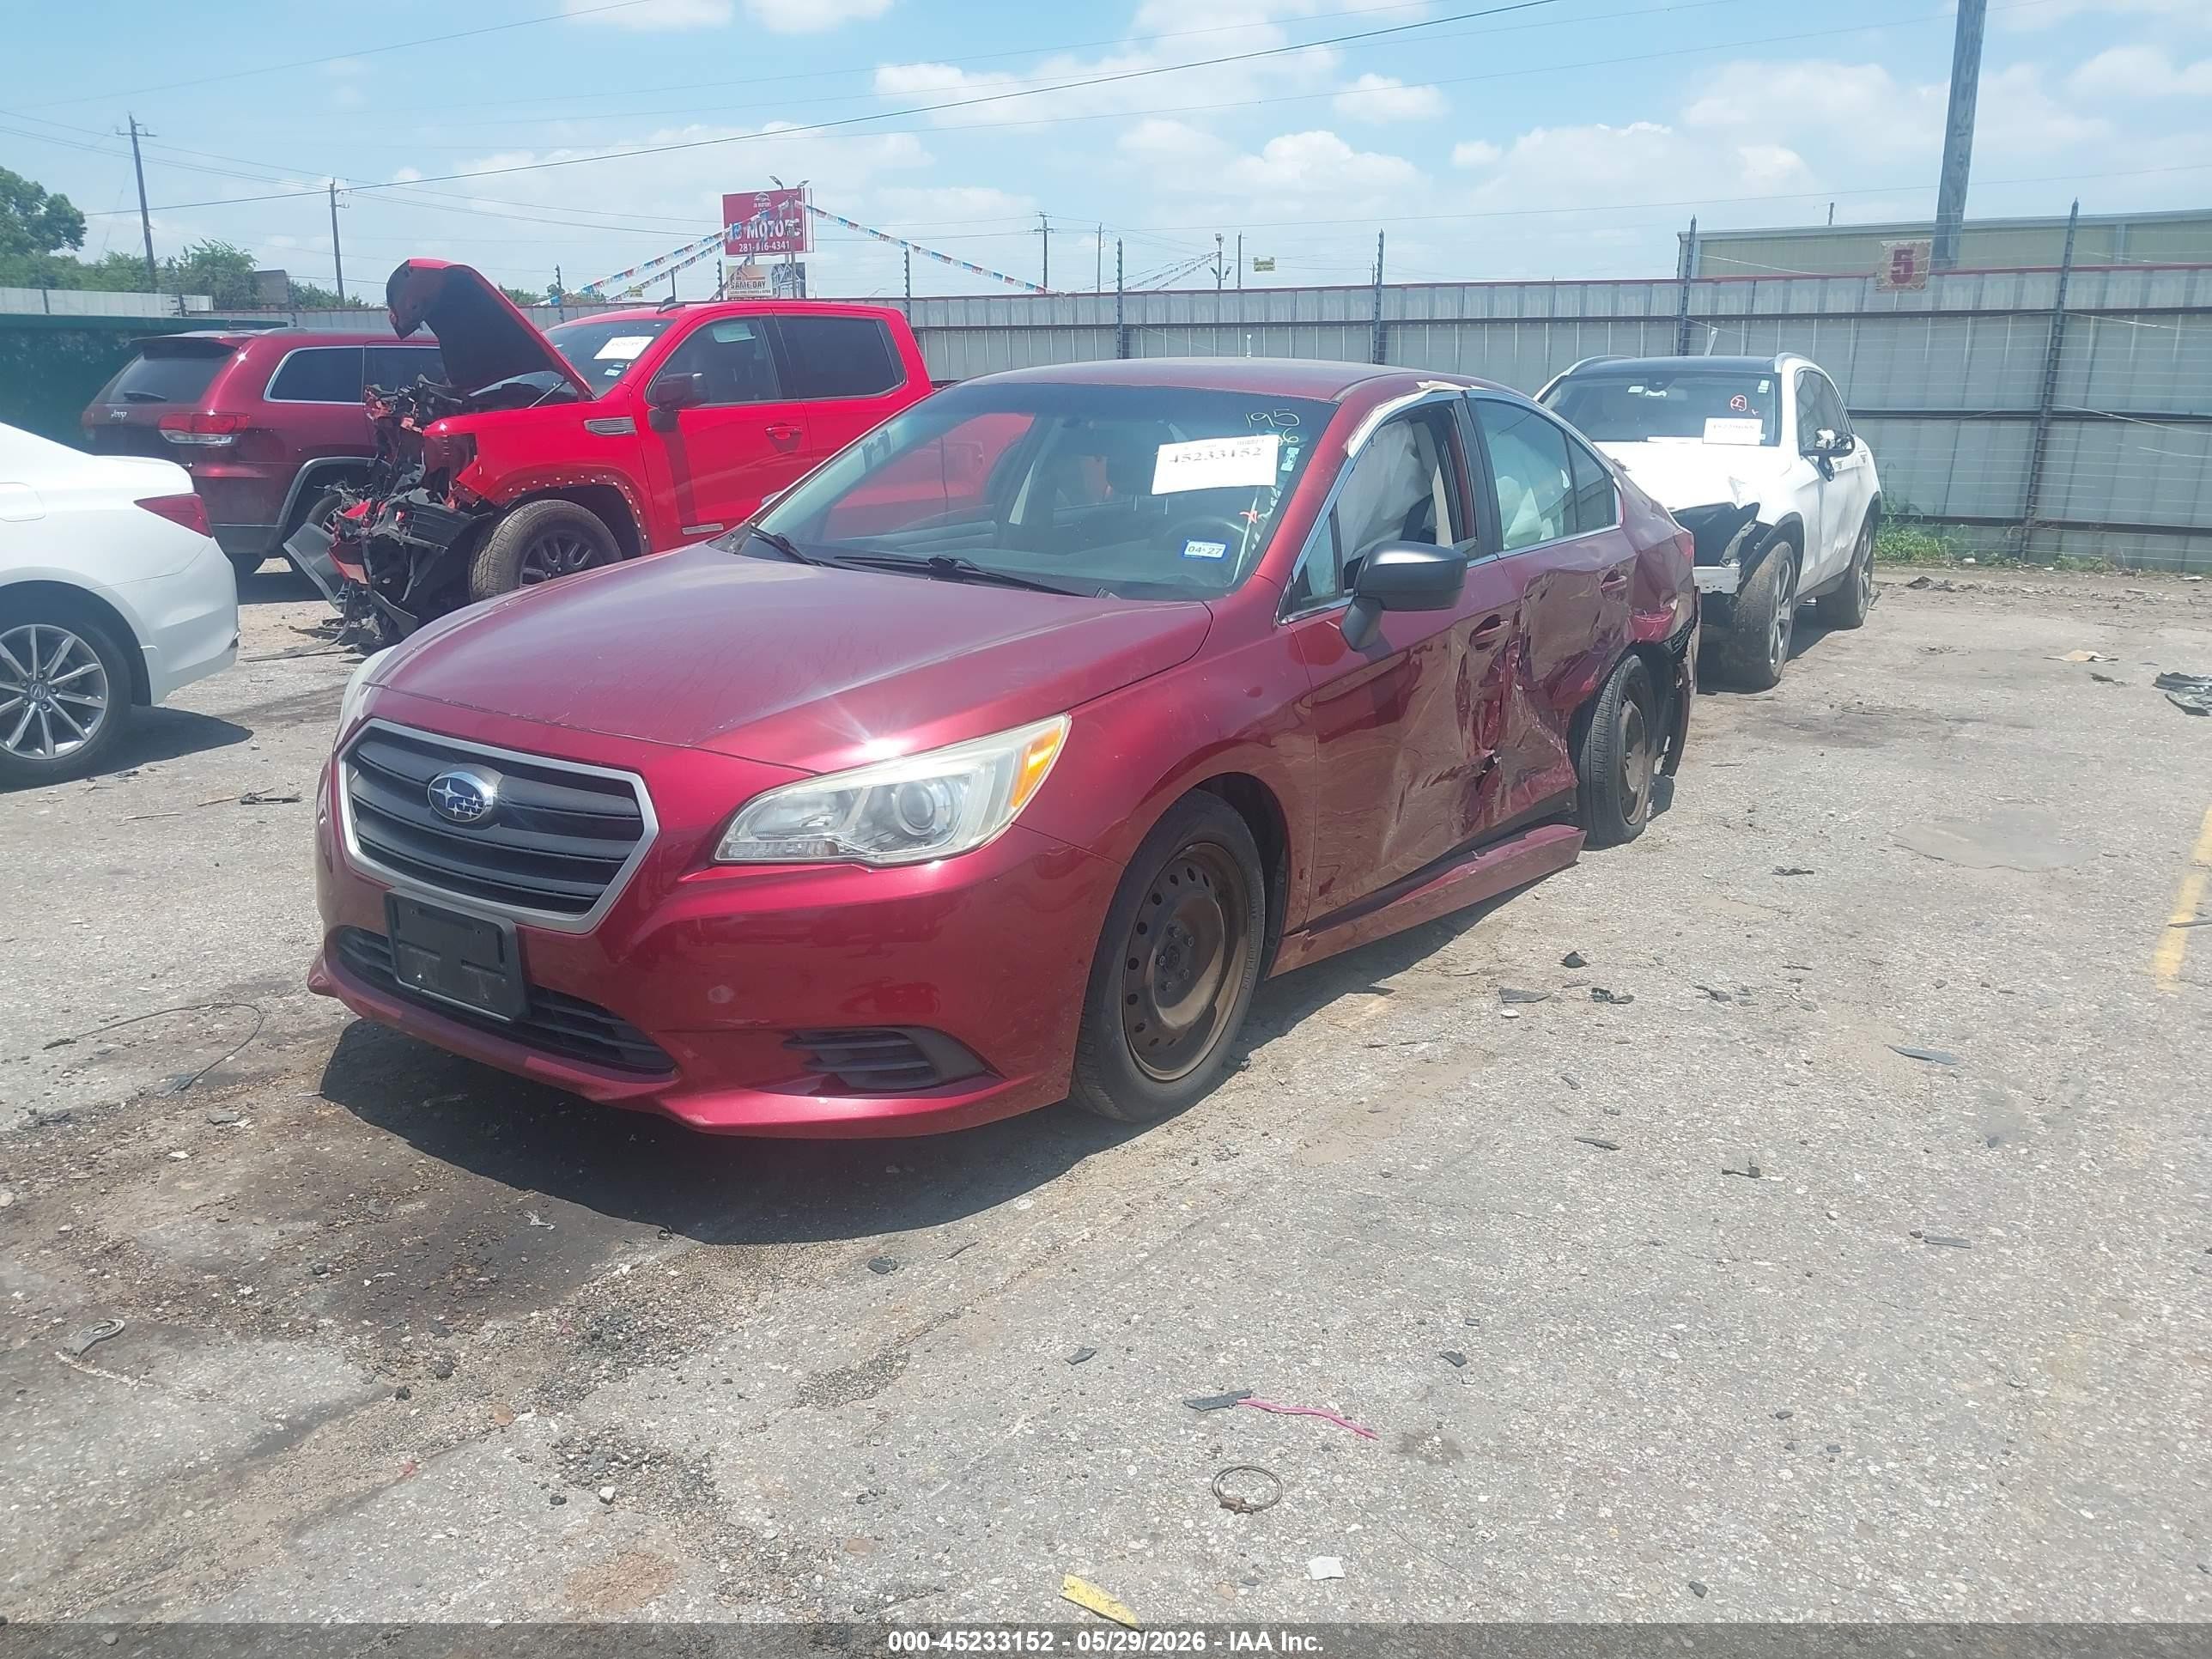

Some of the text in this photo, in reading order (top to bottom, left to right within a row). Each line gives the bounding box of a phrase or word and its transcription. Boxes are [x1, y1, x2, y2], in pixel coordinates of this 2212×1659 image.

[1891, 250, 1914, 283] 5
[730, 280, 766, 289] SAME DAY
[1245, 408, 1300, 428] 195
